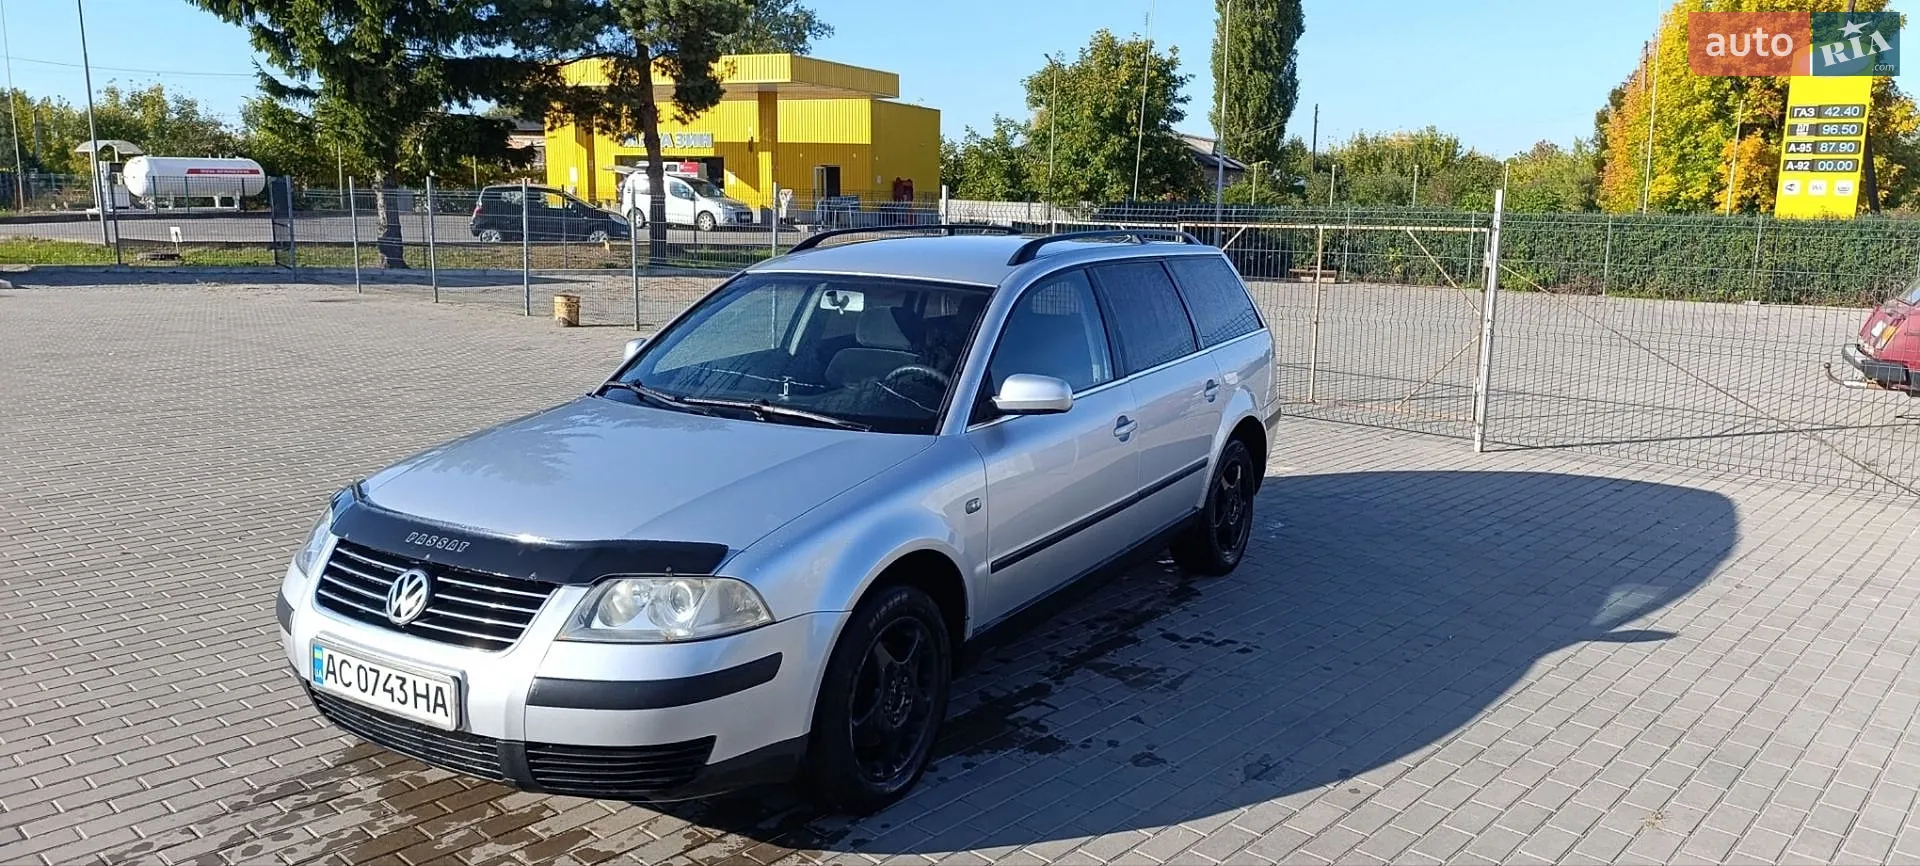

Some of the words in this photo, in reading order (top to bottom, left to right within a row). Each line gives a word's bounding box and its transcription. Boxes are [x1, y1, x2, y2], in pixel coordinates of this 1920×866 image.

[1793, 108, 1815, 117] ГАЗ
[1824, 106, 1860, 116] 42.40
[1822, 124, 1858, 134] 96.50
[1788, 143, 1812, 153] А-95
[1820, 142, 1855, 152] 87.90
[1786, 161, 1810, 170] А-92
[1818, 161, 1853, 171] 00.00
[405, 532, 470, 552] PASSAT
[325, 654, 352, 688] AC
[357, 664, 408, 705] 0743
[413, 680, 449, 717] HA
